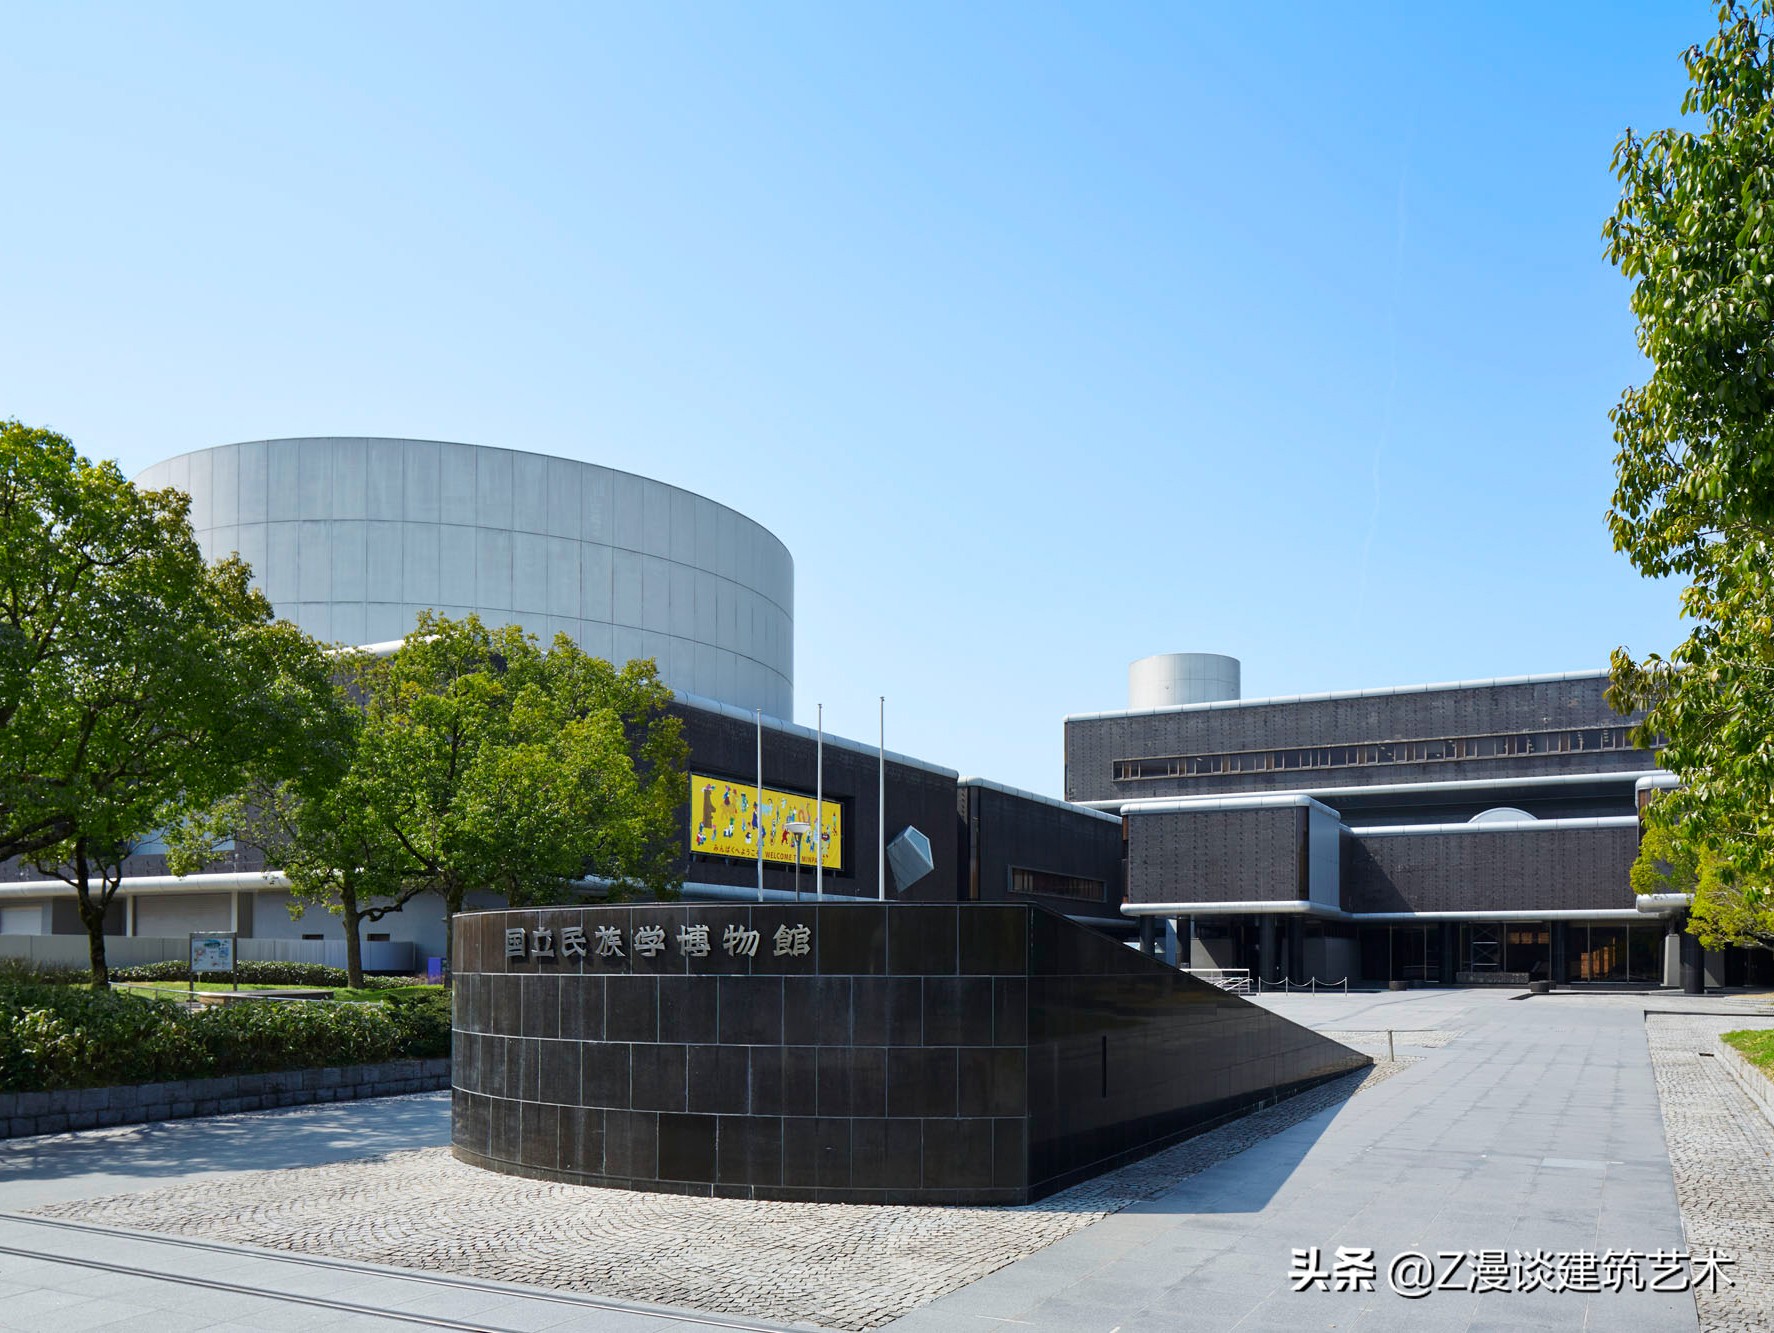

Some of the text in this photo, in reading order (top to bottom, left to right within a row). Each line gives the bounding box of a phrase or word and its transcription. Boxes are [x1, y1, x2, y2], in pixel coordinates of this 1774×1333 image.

[713, 844, 759, 857] みんぱくへようこ
[765, 851, 792, 861] WELCOME
[505, 924, 812, 958] 国立民族学博物館
